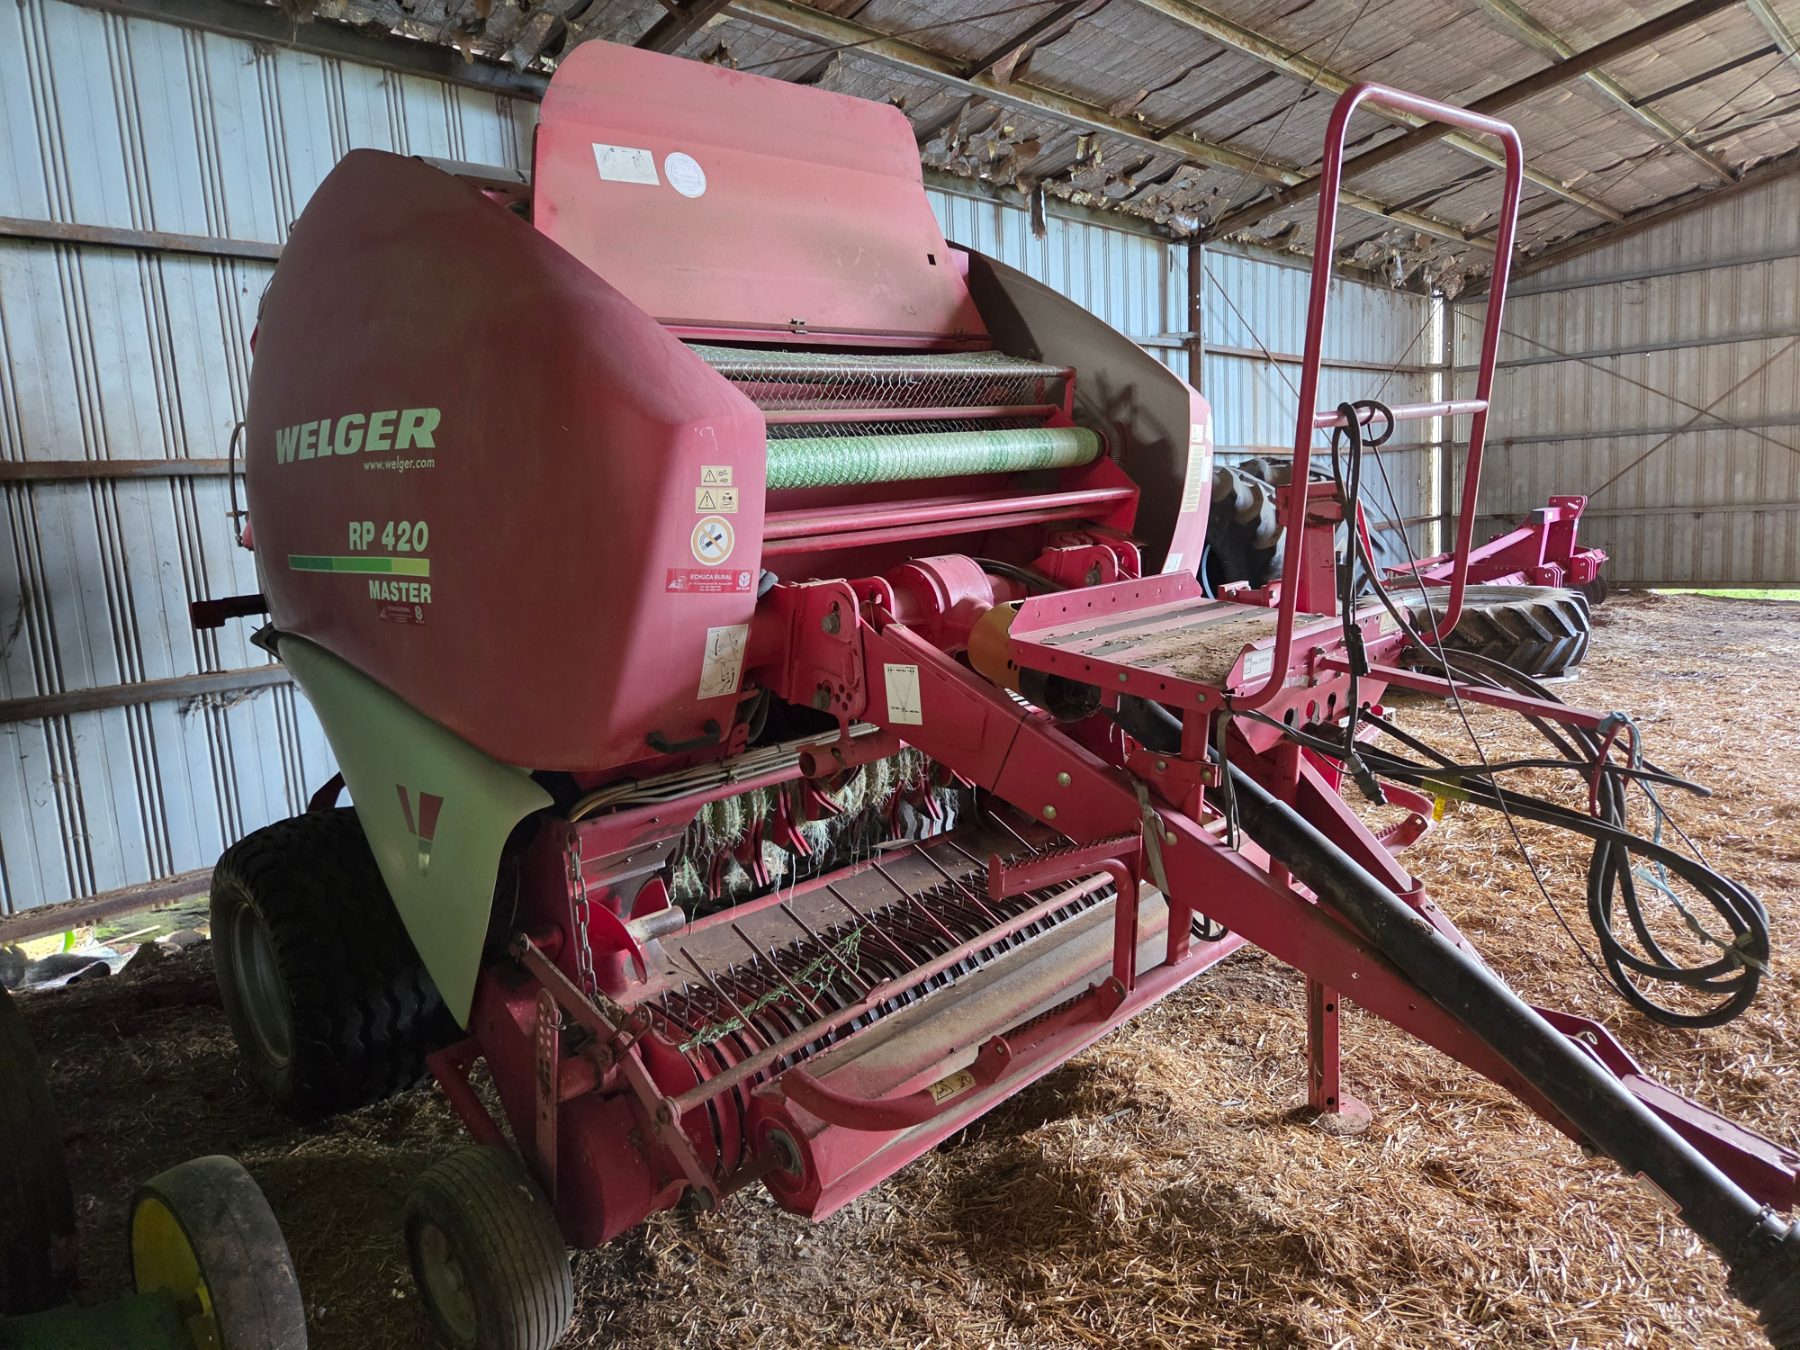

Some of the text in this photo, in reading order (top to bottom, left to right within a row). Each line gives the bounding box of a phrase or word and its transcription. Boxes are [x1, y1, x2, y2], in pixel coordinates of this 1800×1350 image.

[276, 407, 441, 464] WELGER
[364, 456, 435, 473] www.welger.com
[349, 520, 429, 552] RP 420
[369, 579, 432, 604] MASTER
